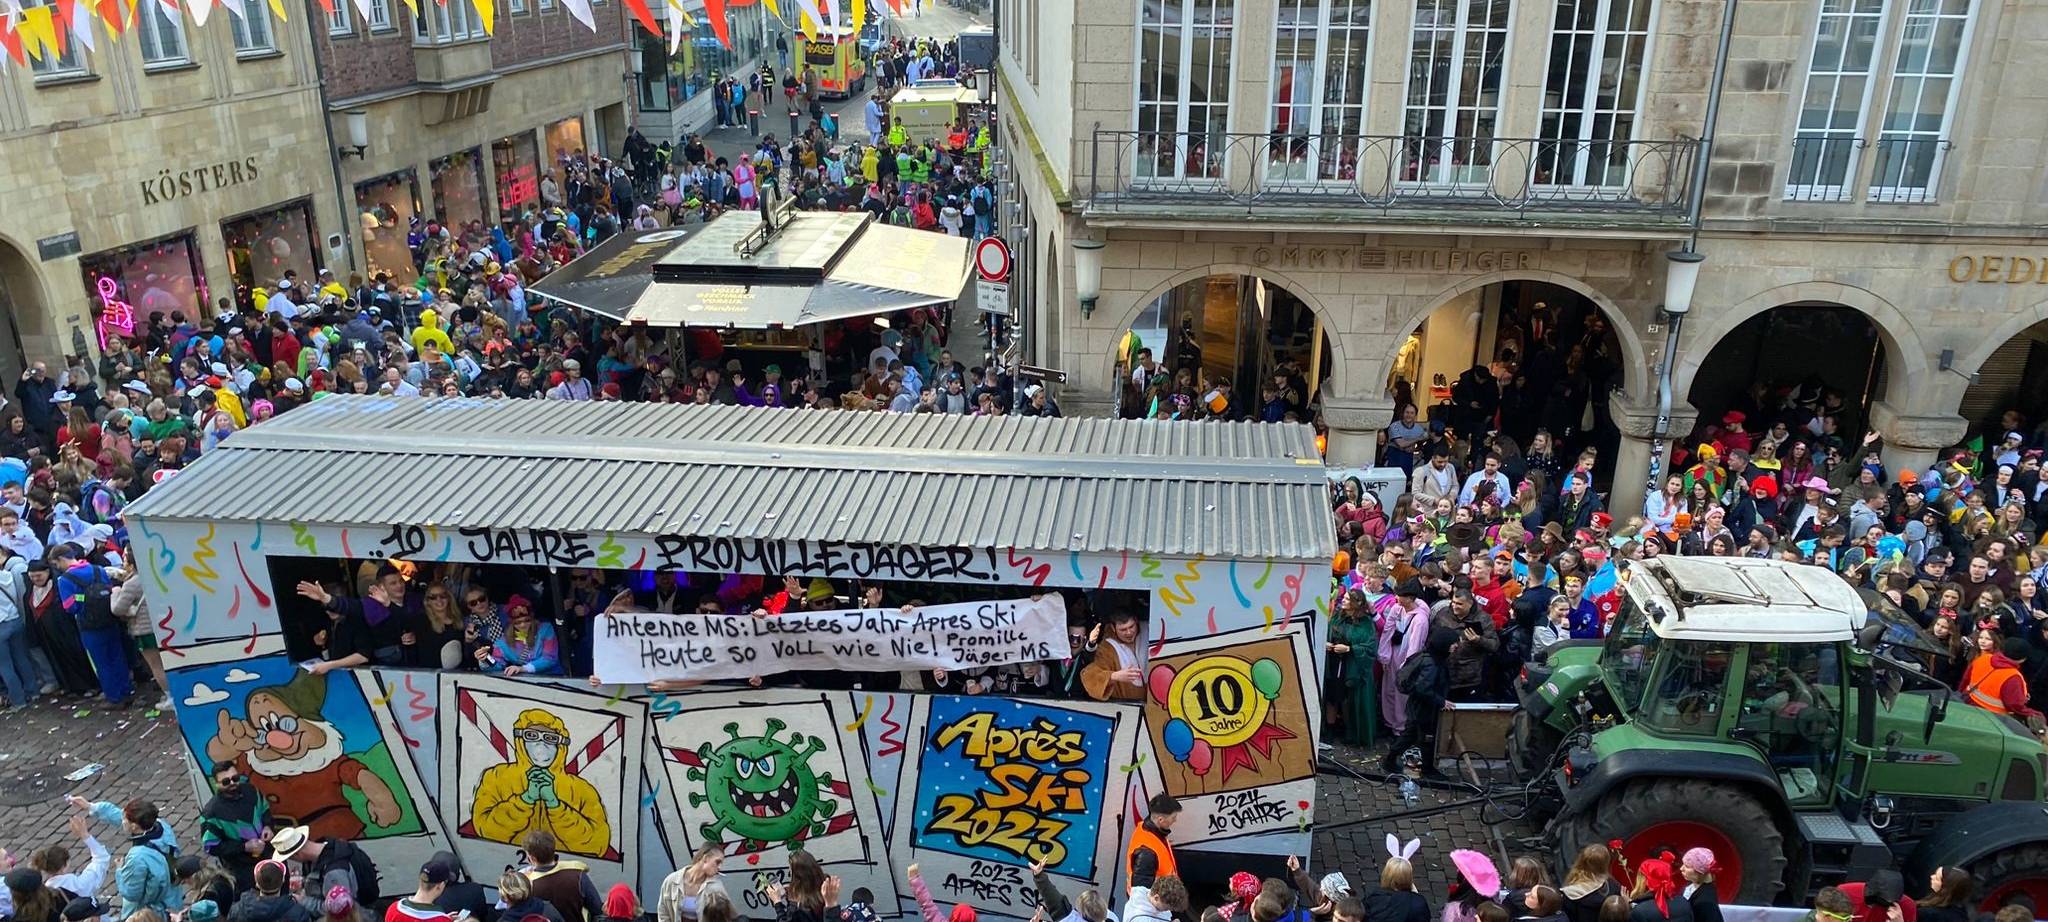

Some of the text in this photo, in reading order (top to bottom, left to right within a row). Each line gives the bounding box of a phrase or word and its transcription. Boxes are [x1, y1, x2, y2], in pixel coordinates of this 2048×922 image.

[813, 44, 834, 55] ASB
[140, 156, 259, 206] KÖSTERS
[502, 176, 538, 210] LIEBE
[1232, 247, 1530, 271] TOMMY HILFIGER
[459, 526, 595, 565] JAHRE
[654, 534, 1001, 582] PROMILLEJÄGER!
[606, 603, 1017, 638] Antenne MS: Letztes Jahr Apres Ski
[640, 638, 716, 669] Heute
[731, 645, 757, 664] so
[832, 640, 880, 658] wie
[890, 634, 939, 657] Nie!
[946, 629, 1028, 647] Promille
[952, 641, 1051, 665] Jäger MS
[1191, 674, 1243, 720] 10
[931, 712, 1089, 770] Après
[1209, 717, 1243, 733] Jahre
[976, 763, 1091, 813] Ski
[1215, 789, 1267, 813] 2024
[923, 794, 1072, 867] 2023
[1208, 800, 1294, 836] 10 JAHRE
[942, 873, 1012, 906] APRES
[970, 860, 1024, 885] 2023
